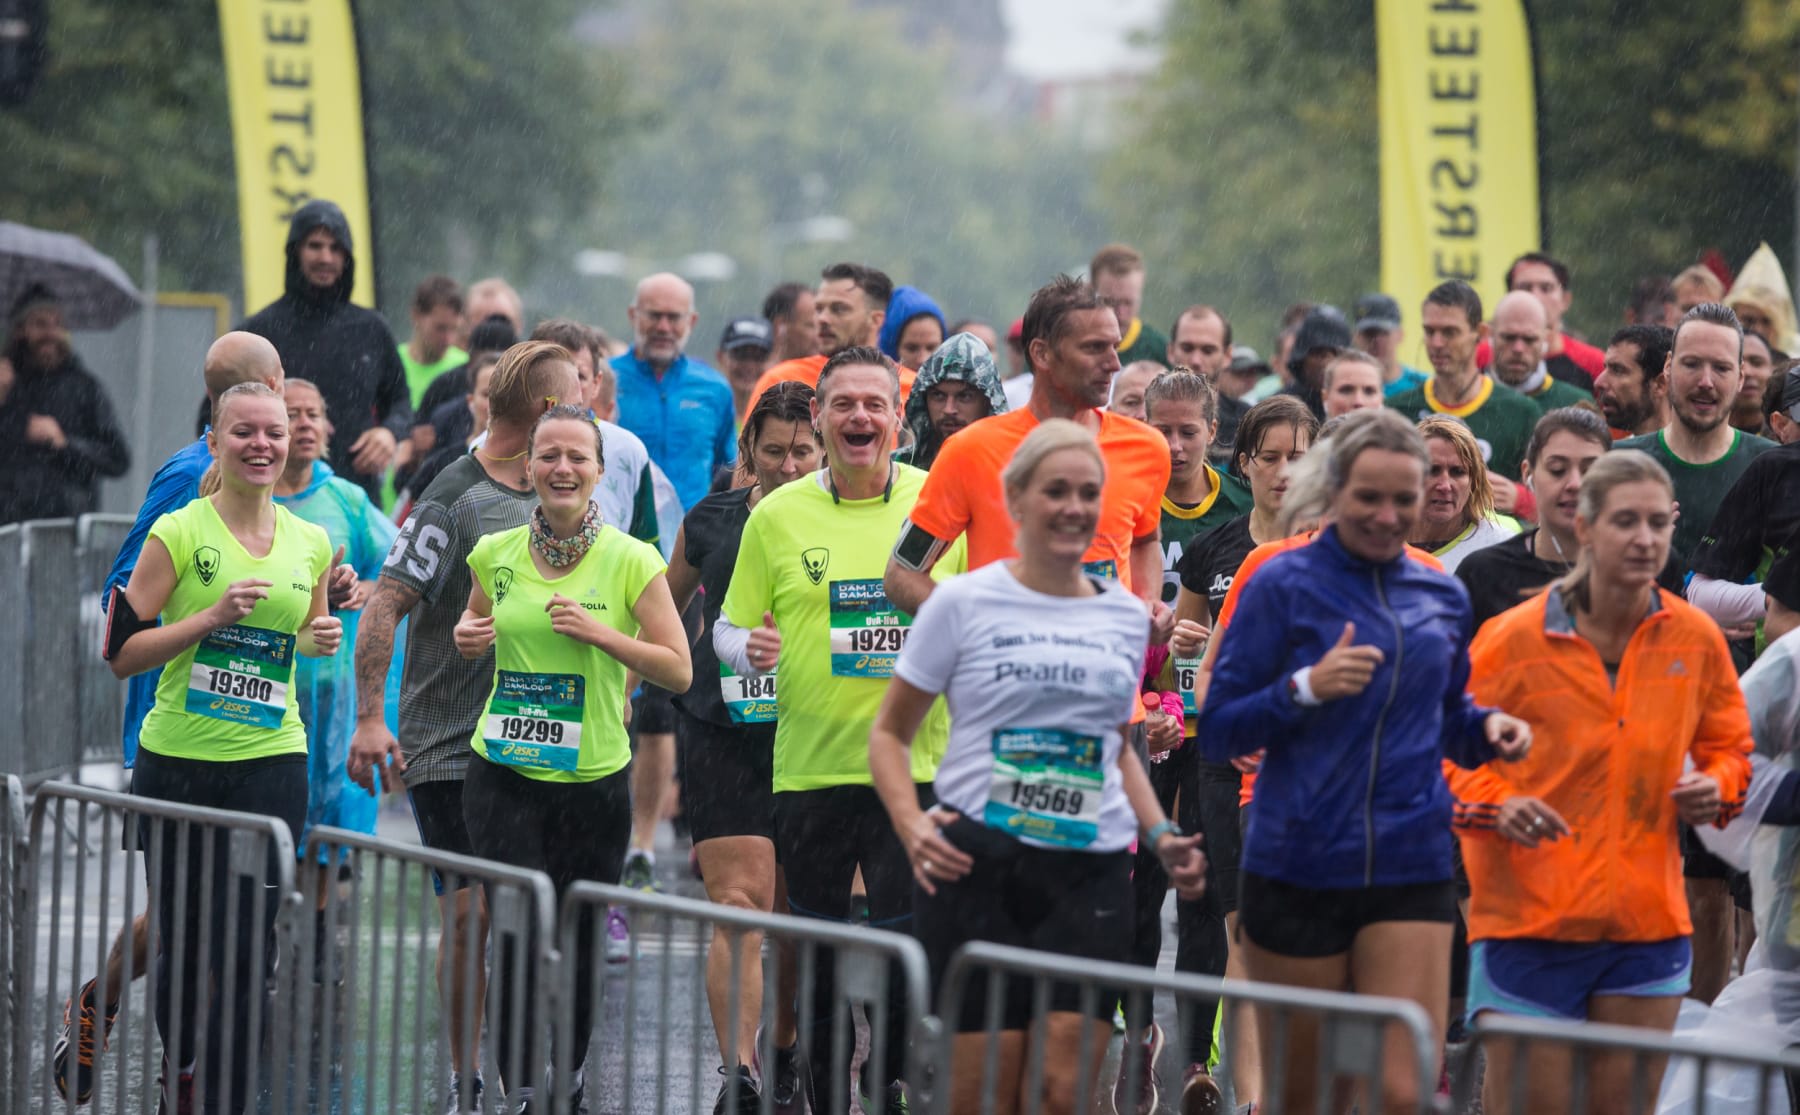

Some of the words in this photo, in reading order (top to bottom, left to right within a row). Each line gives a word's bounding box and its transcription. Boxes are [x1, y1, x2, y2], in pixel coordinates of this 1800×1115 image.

[839, 584, 866, 592] DAM
[211, 631, 269, 647] DAMLOOP
[995, 661, 1087, 682] Pearle
[209, 669, 273, 702] 19300
[504, 682, 552, 692] DAMLOOP
[738, 677, 776, 699] 184
[501, 717, 564, 745] 19299
[1011, 781, 1084, 816] 19569
